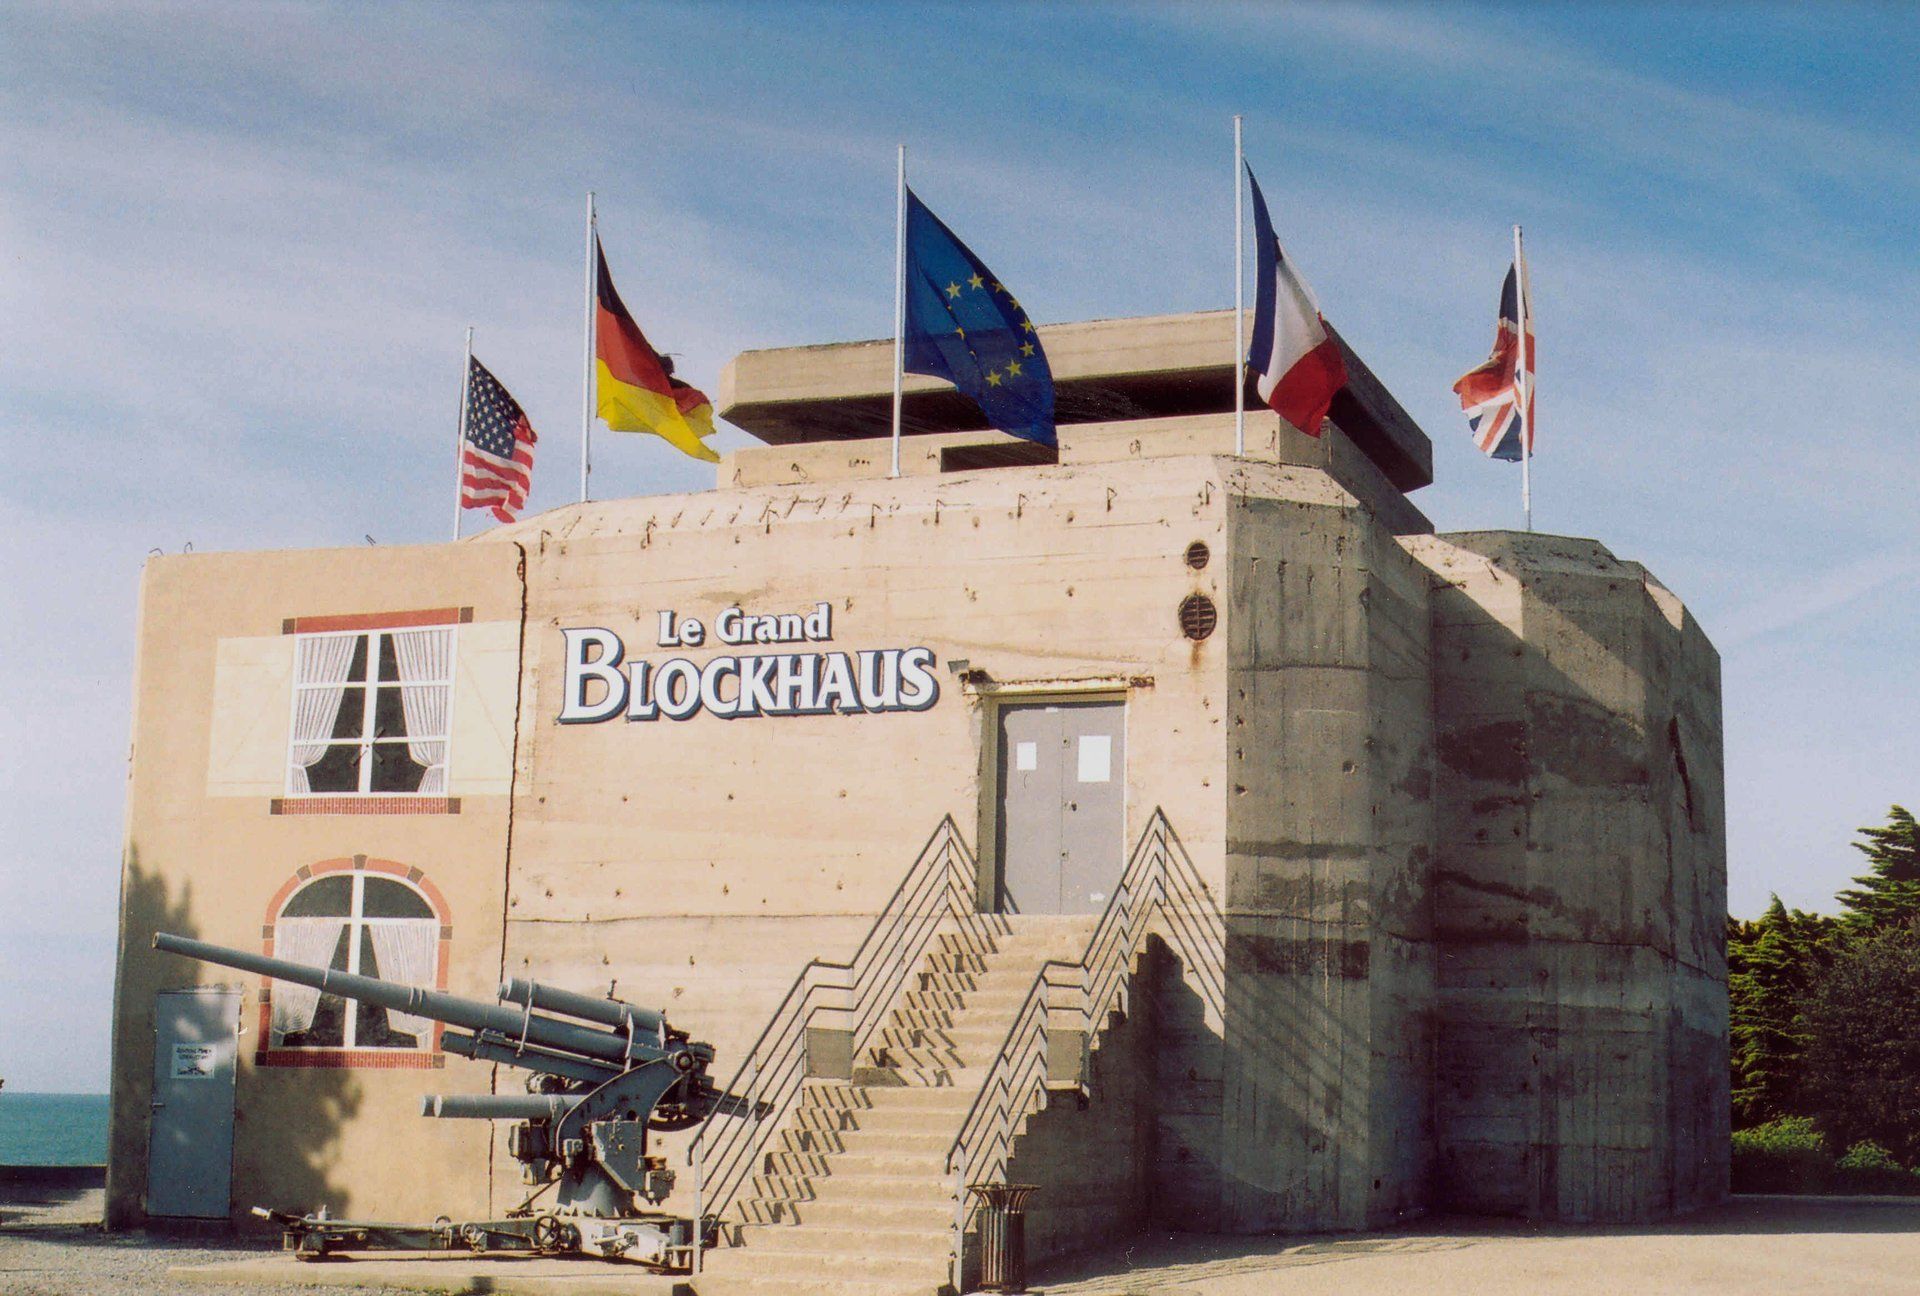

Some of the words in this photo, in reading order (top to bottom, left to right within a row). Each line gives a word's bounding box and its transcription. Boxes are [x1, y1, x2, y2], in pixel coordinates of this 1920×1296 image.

[657, 611, 705, 647] Le
[715, 603, 832, 645] Grand
[558, 627, 940, 723] BLOCKHAUS
